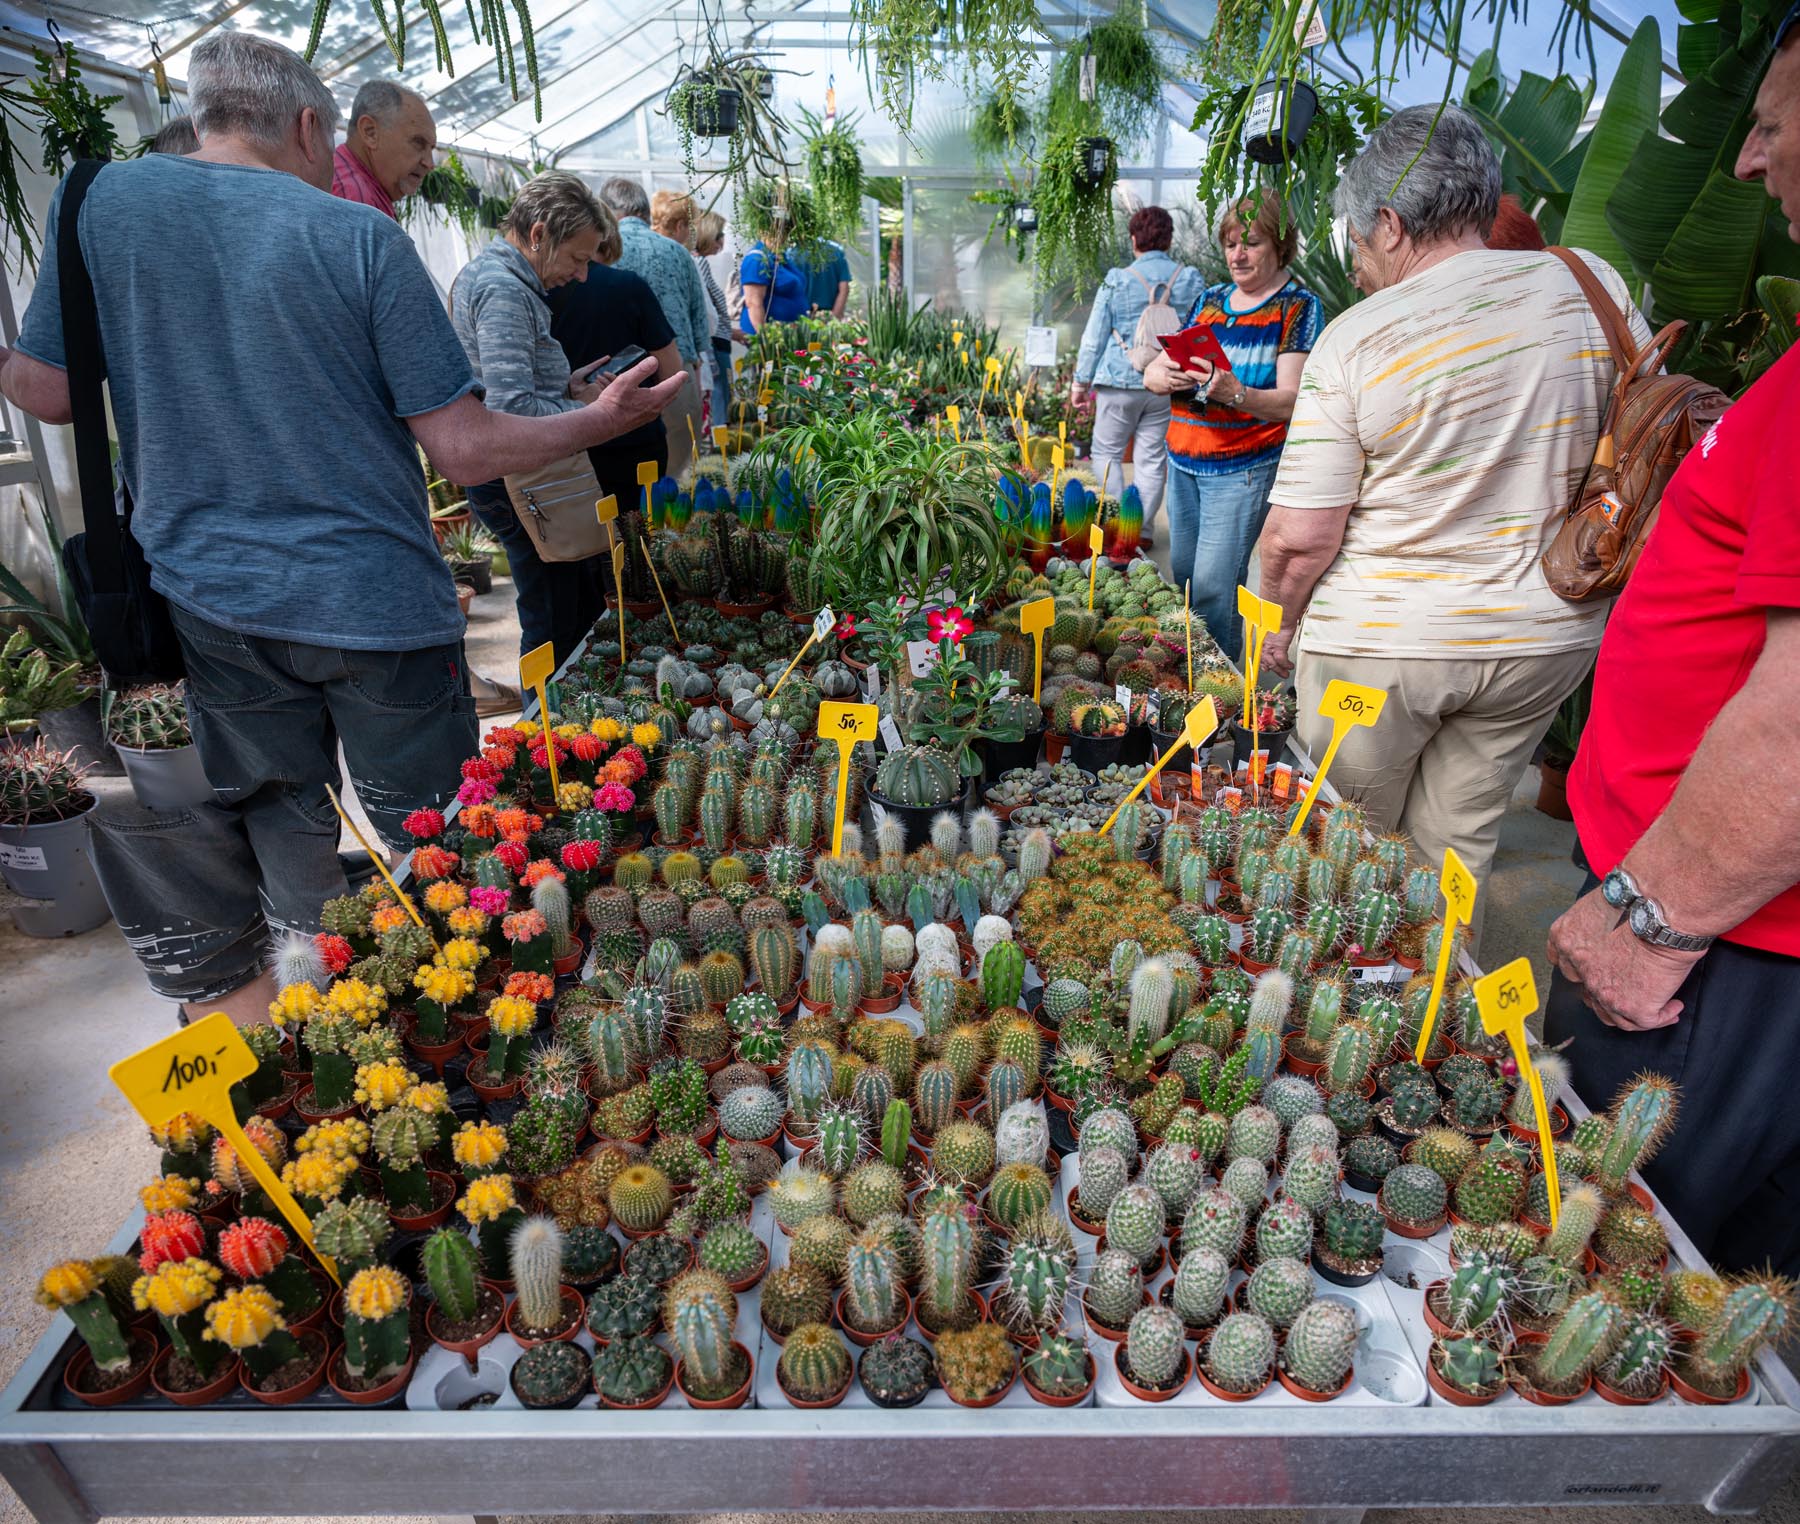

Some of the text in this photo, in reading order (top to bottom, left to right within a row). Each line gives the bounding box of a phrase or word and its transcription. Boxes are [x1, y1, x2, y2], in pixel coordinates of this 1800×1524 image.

[1339, 694, 1375, 717] 50,-
[837, 713, 864, 733] 50,-
[1497, 980, 1528, 1009] 50,-
[162, 1045, 228, 1093] 100,-
